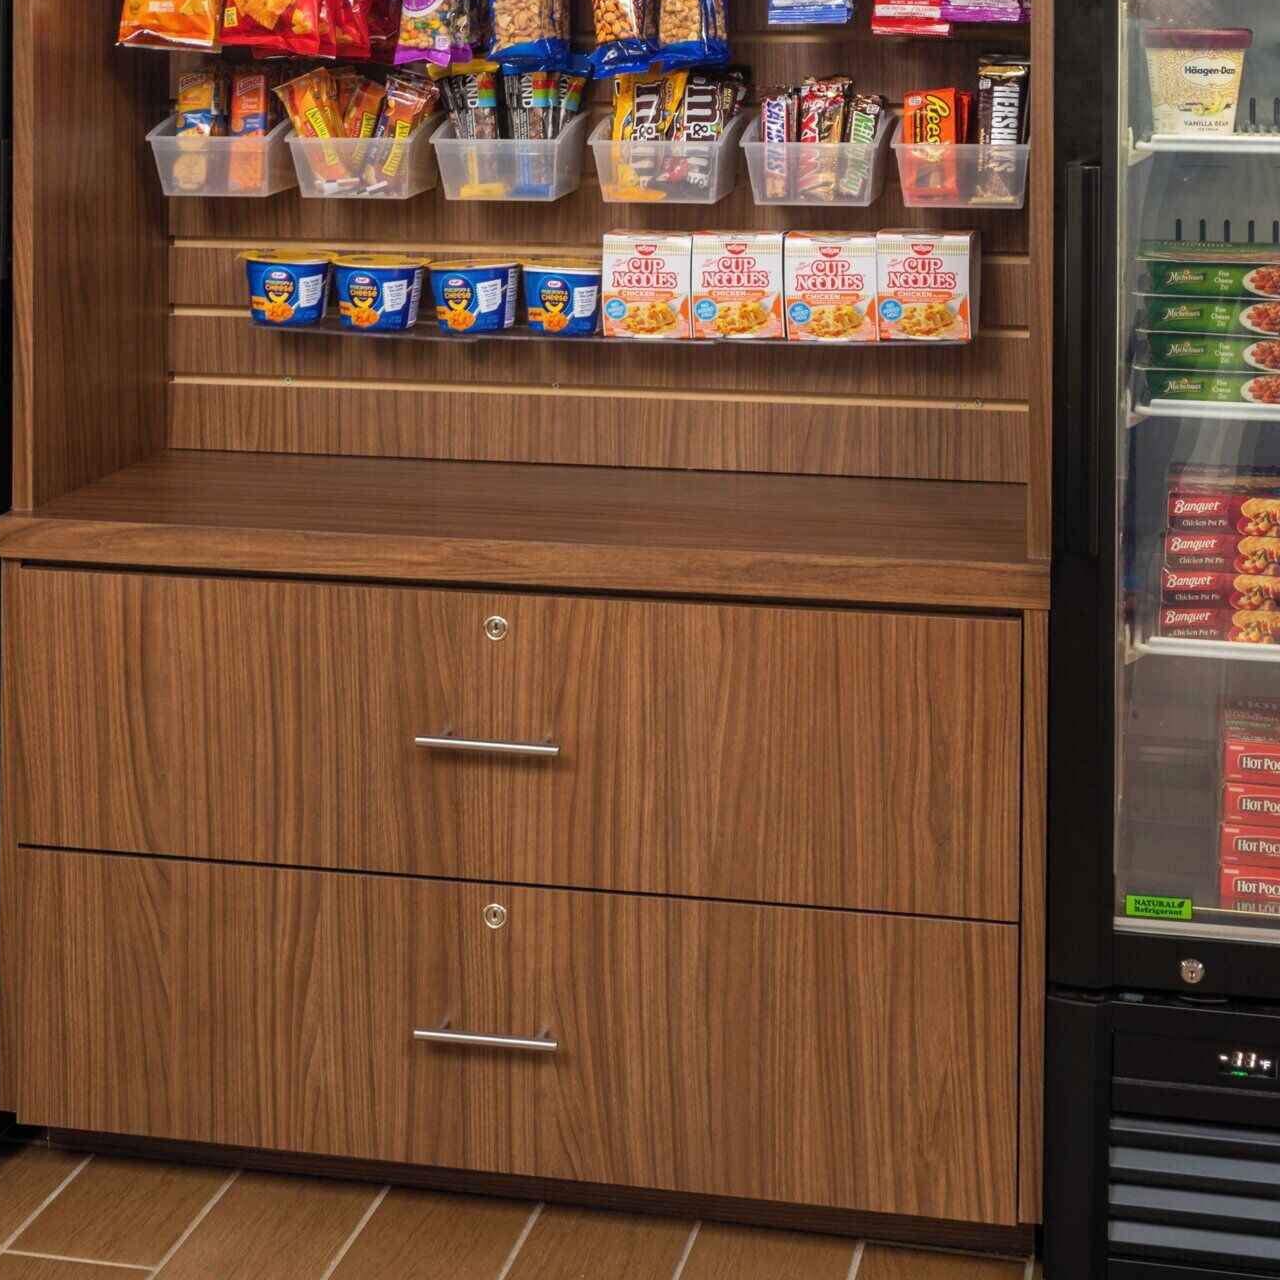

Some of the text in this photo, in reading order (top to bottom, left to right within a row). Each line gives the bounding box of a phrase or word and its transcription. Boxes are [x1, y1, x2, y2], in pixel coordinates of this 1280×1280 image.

[1184, 65, 1236, 77] Häagen-Dazs
[466, 74, 479, 108] KIND
[522, 73, 534, 108] KIND
[628, 257, 665, 273] CUP
[811, 260, 850, 275] CUP
[612, 271, 678, 289] NOODLES
[795, 274, 864, 291] NOODLES
[1169, 271, 1205, 283] Michelina's
[265, 284, 294, 292] Cheese
[444, 292, 472, 300] Cheese
[1173, 499, 1221, 514] Banquet
[1171, 537, 1218, 551] Banquet
[1242, 756, 1262, 769] HOT
[1134, 898, 1178, 908] NATURAL
[1134, 906, 1183, 916] Refrigerant
